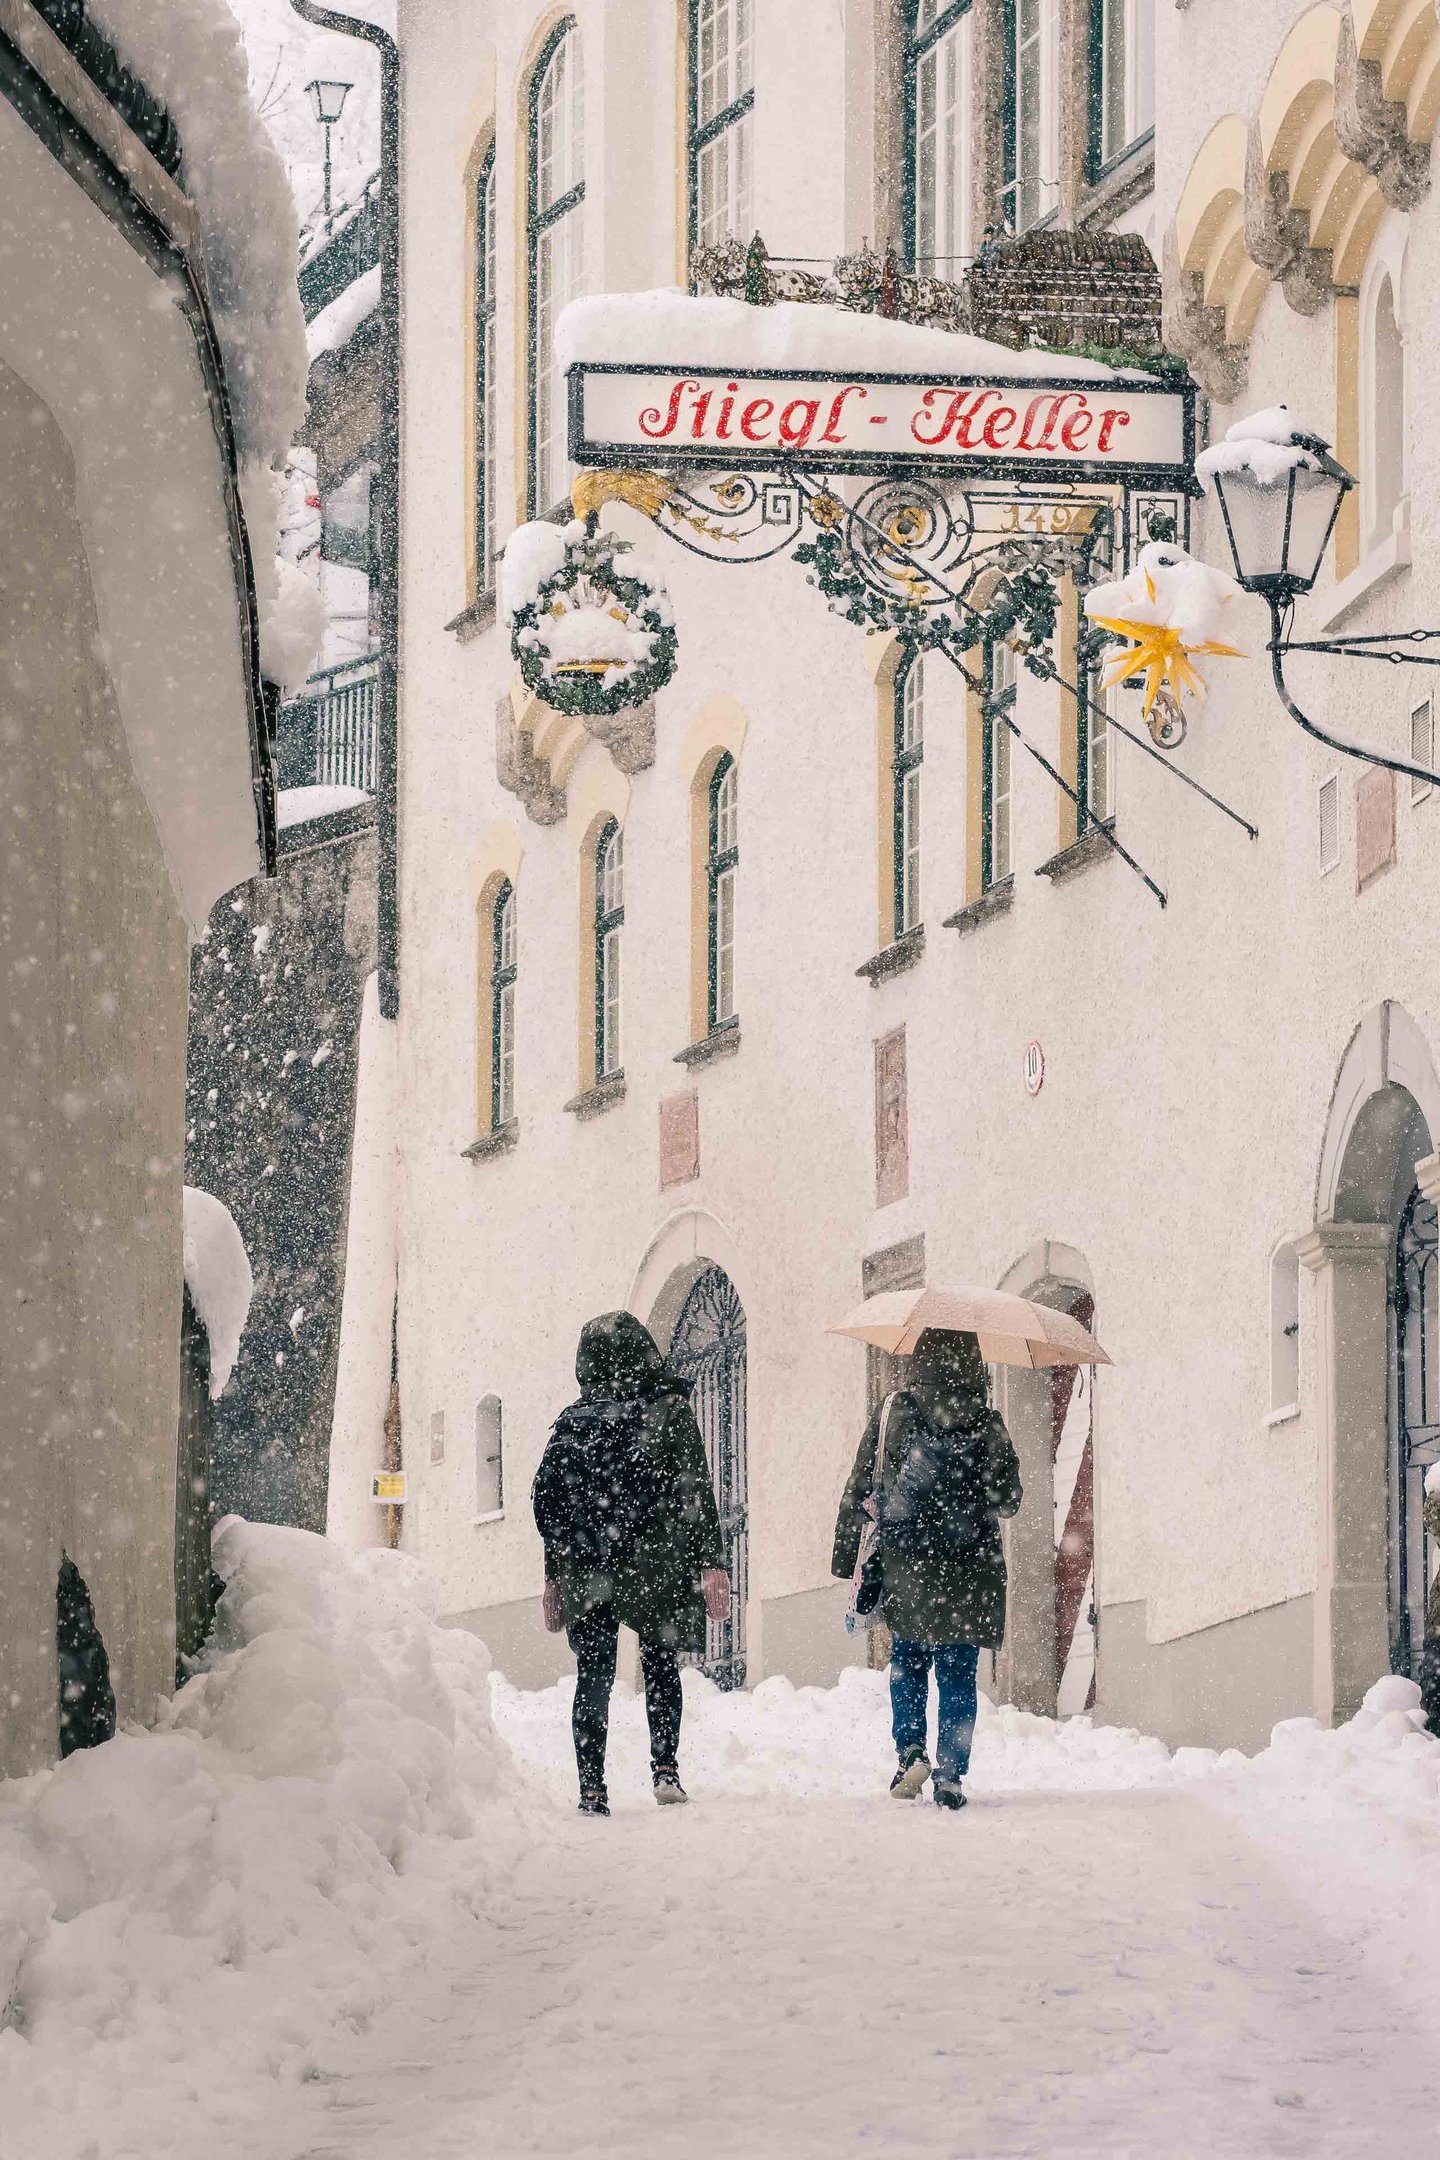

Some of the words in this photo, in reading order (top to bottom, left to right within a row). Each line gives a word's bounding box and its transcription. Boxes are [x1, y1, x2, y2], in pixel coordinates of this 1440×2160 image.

[639, 380, 868, 449] Stiegl
[911, 388, 1131, 454] Keller
[1027, 1047, 1038, 1077] 10
